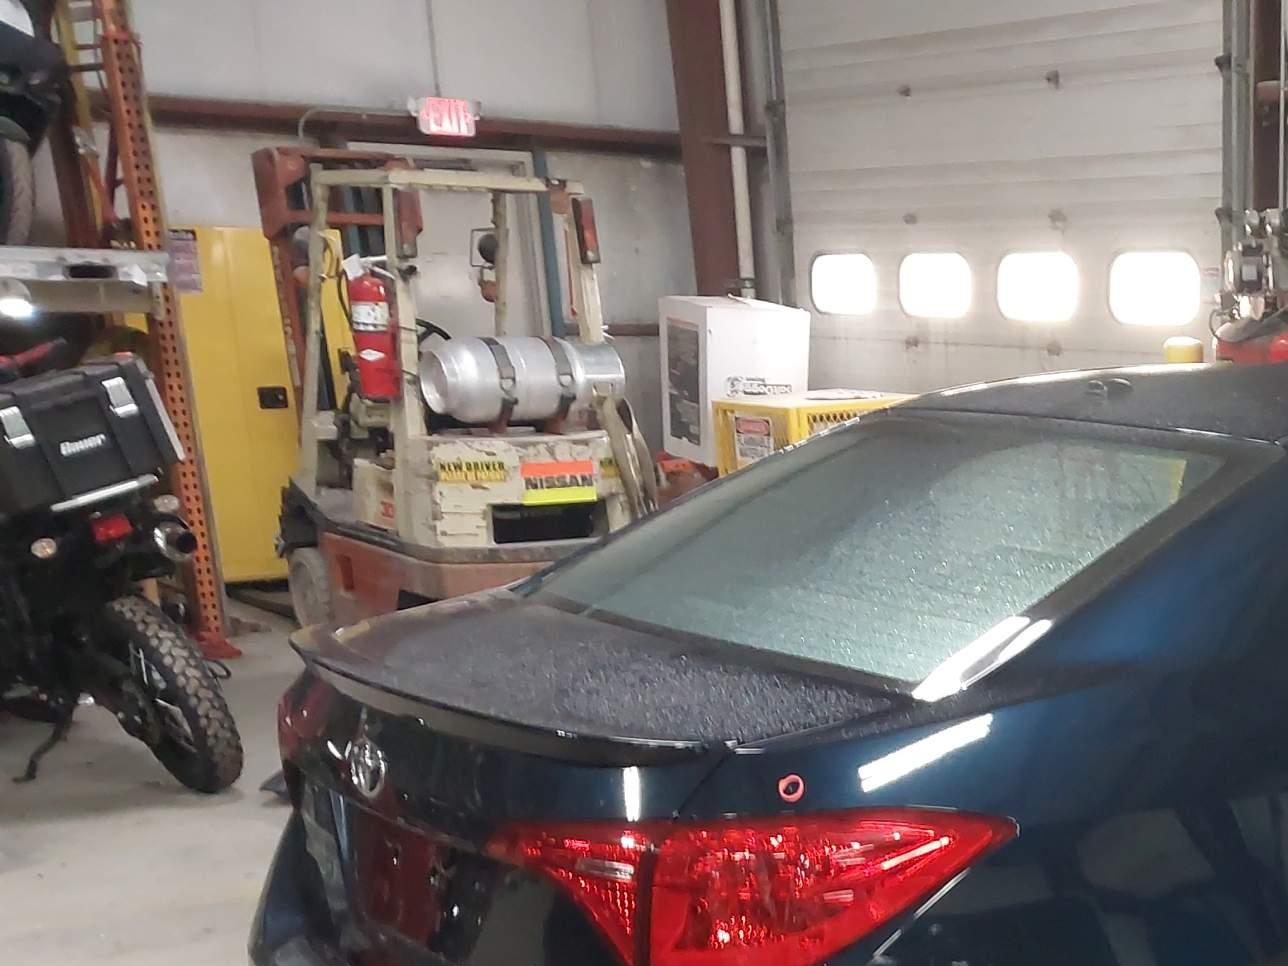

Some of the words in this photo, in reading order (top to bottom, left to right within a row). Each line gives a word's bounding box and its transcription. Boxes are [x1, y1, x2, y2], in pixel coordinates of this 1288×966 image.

[427, 98, 470, 133] EXIT
[440, 459, 463, 471] NEW
[465, 460, 505, 471] DRIVER
[525, 465, 594, 489] NISSAN
